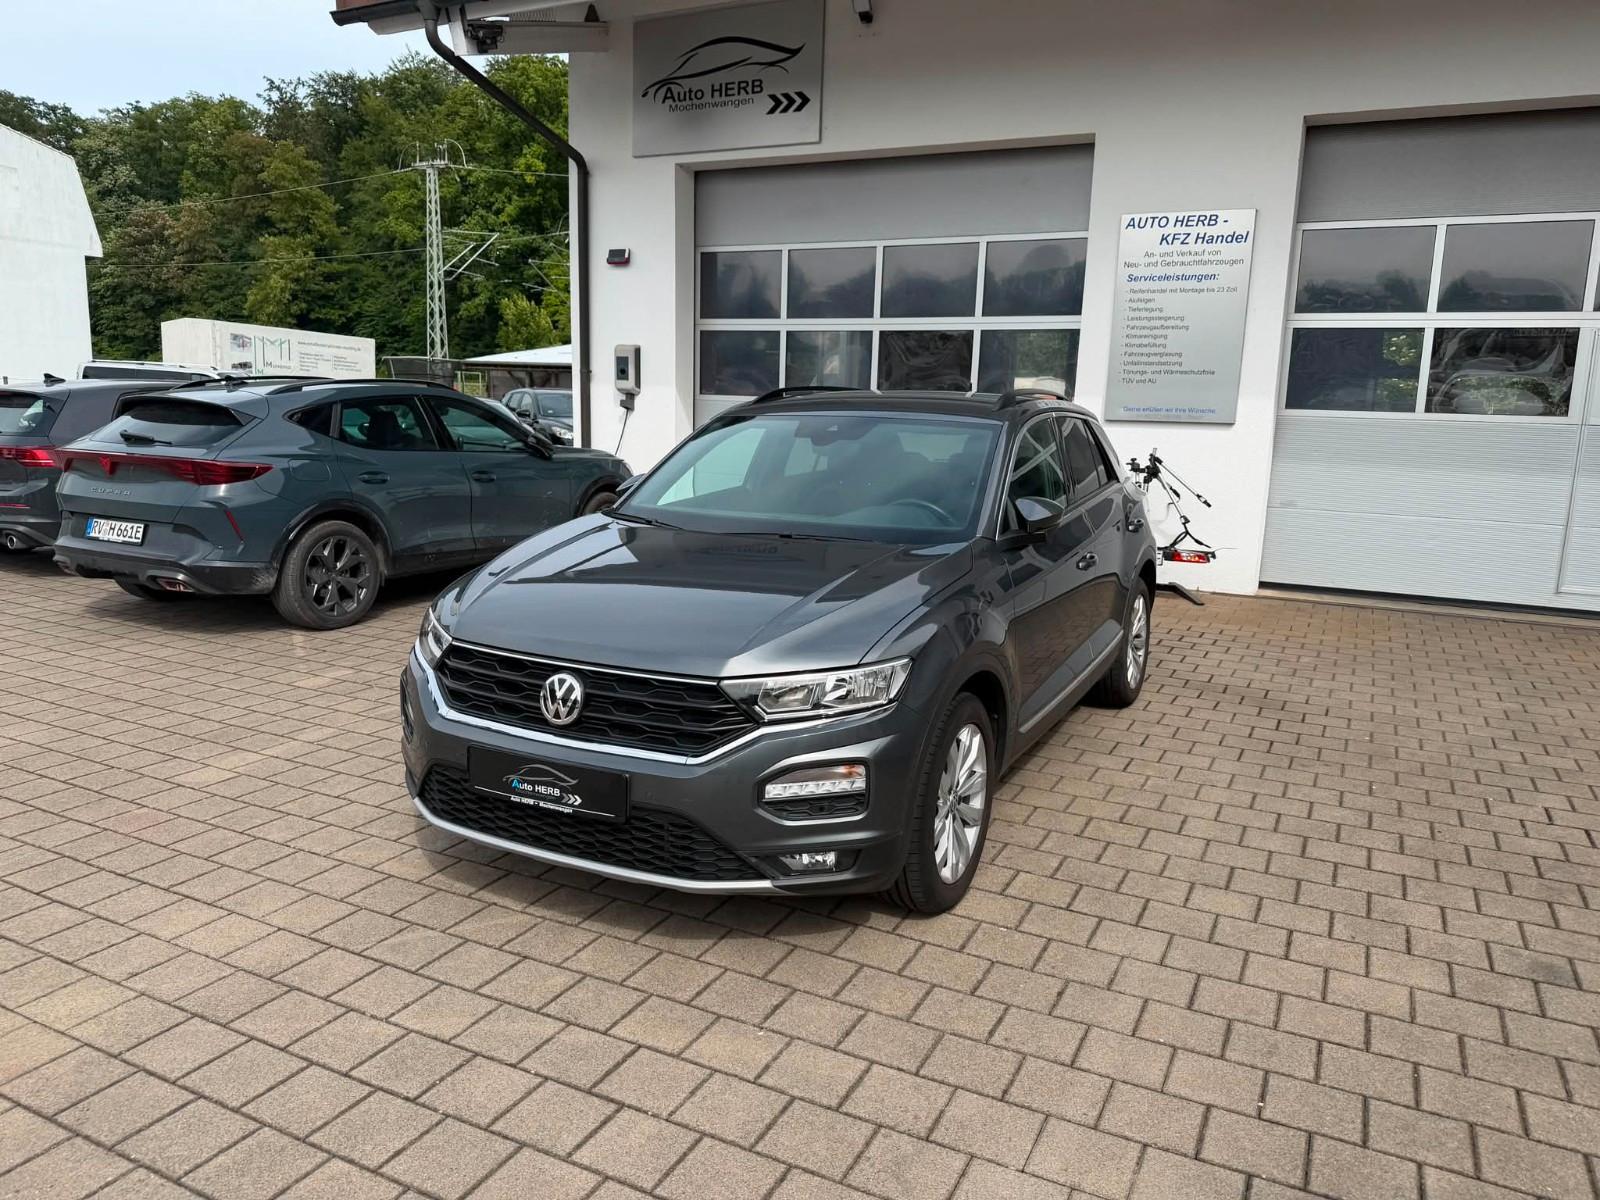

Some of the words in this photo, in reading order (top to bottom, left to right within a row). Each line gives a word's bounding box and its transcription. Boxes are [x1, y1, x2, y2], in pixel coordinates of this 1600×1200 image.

[661, 86, 704, 104] Auto
[710, 79, 764, 99] HERB
[668, 97, 754, 112] Mochenwangen
[1125, 216, 1169, 230] AUTO
[1173, 214, 1219, 228] HERB
[1159, 232, 1191, 246] KFZ
[1194, 231, 1250, 244] Handel
[1159, 250, 1173, 258] und
[1176, 249, 1206, 257] Verkauf
[1123, 261, 1142, 269] Neu-
[1143, 260, 1158, 268] und
[1160, 258, 1244, 268] Gebrauchtfahrzeugen
[1126, 273, 1220, 283] Serviceleistungen:
[512, 778, 532, 791] Auto
[535, 784, 560, 798] HERB
